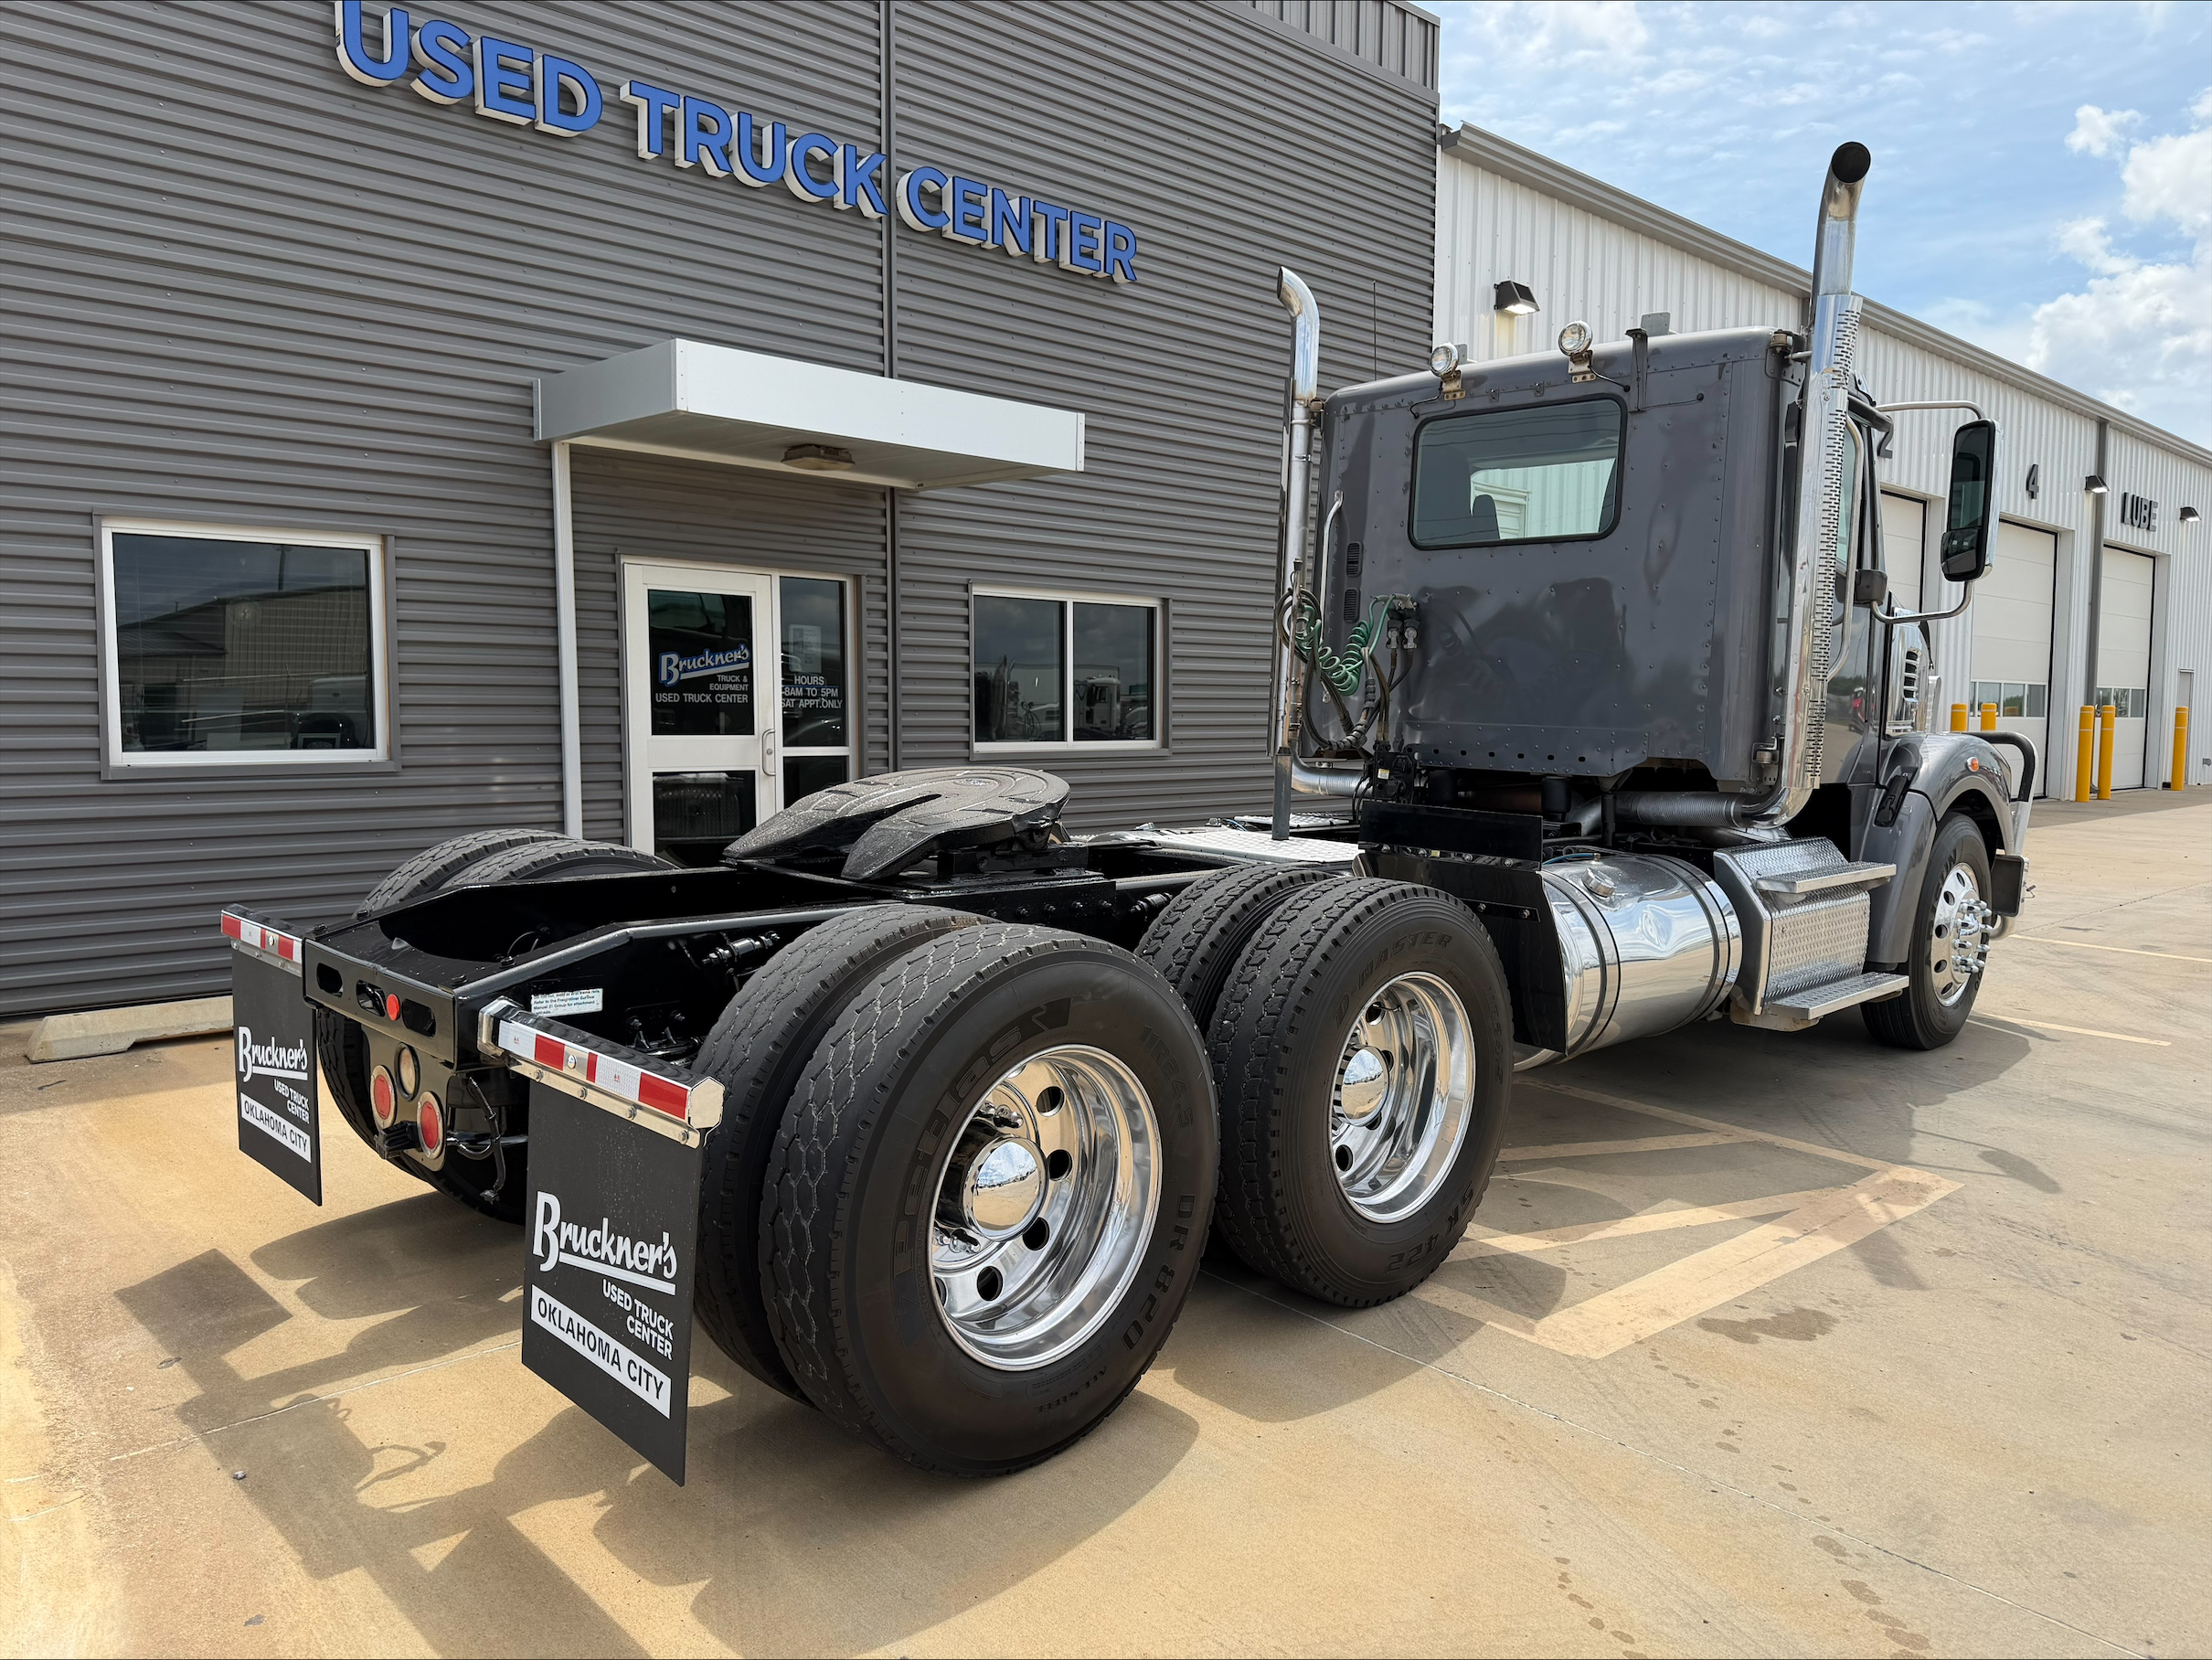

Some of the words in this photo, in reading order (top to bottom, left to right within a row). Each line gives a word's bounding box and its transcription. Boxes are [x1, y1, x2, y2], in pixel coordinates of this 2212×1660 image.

[335, 0, 603, 136] USED
[622, 80, 889, 218] TRUCK
[898, 166, 1138, 282] CENTER
[2026, 463, 2039, 500] 4
[2122, 492, 2159, 533] LUBE
[660, 644, 750, 686] Bruckner's
[717, 675, 740, 683] TRUCK
[742, 675, 748, 683] &
[793, 676, 824, 686] HOURS
[655, 693, 680, 703] USED
[682, 693, 713, 703] TRUCK
[715, 694, 748, 704] CENTER
[709, 683, 749, 691] EQUIPMENT
[805, 687, 817, 697] TO
[821, 687, 838, 697] 5PM
[1333, 931, 1453, 1028] D-MASTER
[239, 1026, 308, 1082] Bruckner's
[274, 1079, 289, 1098] USED
[290, 1088, 310, 1111] TRUCK
[286, 1100, 310, 1124] CENTER
[244, 1100, 288, 1140] OKLAHOMA
[289, 1129, 307, 1153] CITY
[1165, 1192, 1196, 1251] DR
[1445, 1180, 1473, 1237] SK
[533, 1190, 677, 1279] Bruckner's
[1385, 1232, 1441, 1274] 422
[602, 1279, 633, 1312] USED
[633, 1299, 674, 1340] TRUCK
[1121, 1261, 1175, 1352] 820
[537, 1297, 622, 1373] OKLAHOMA
[627, 1358, 664, 1400] CITY
[626, 1317, 673, 1360] CENTER
